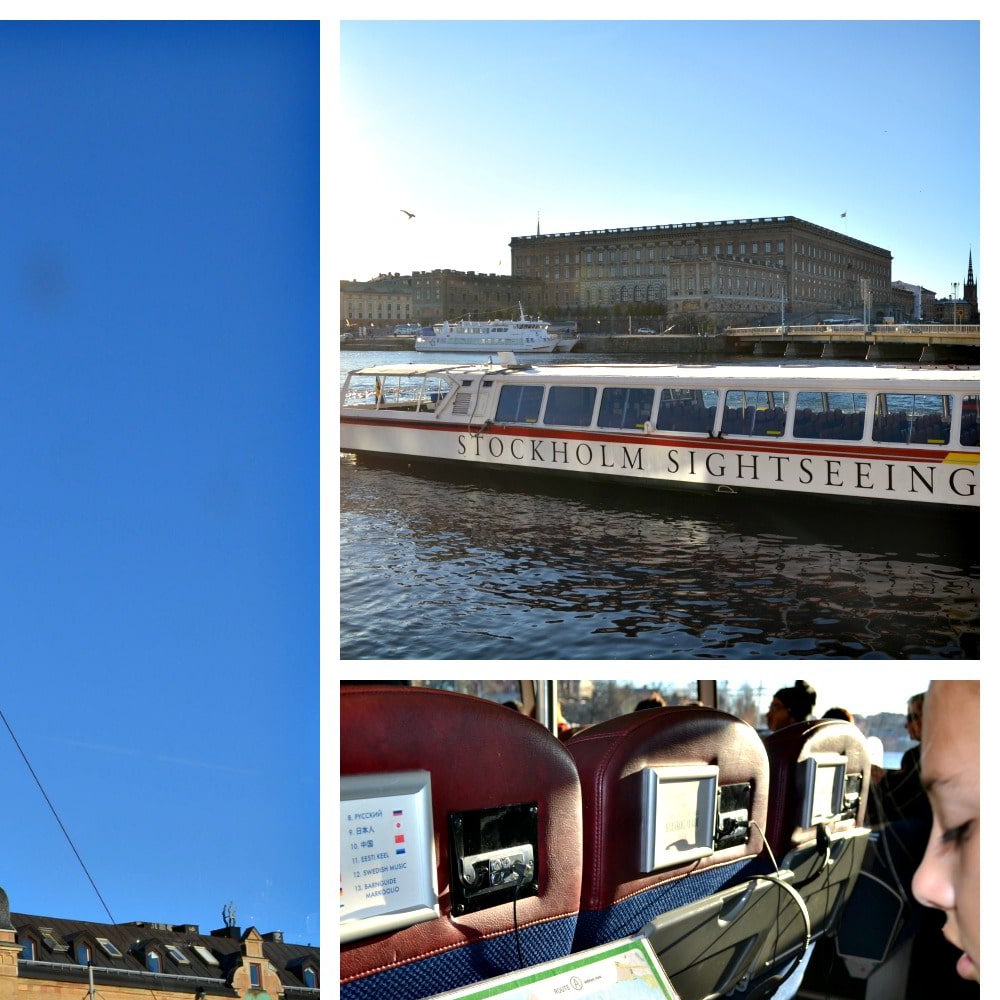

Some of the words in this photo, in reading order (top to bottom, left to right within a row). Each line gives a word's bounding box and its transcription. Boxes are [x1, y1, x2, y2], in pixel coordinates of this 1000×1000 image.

[457, 434, 645, 470] STOCKHOLM
[667, 449, 977, 497] SIGHTSEEING
[363, 867, 388, 876] SWEDISH
[389, 862, 407, 871] MUSIC
